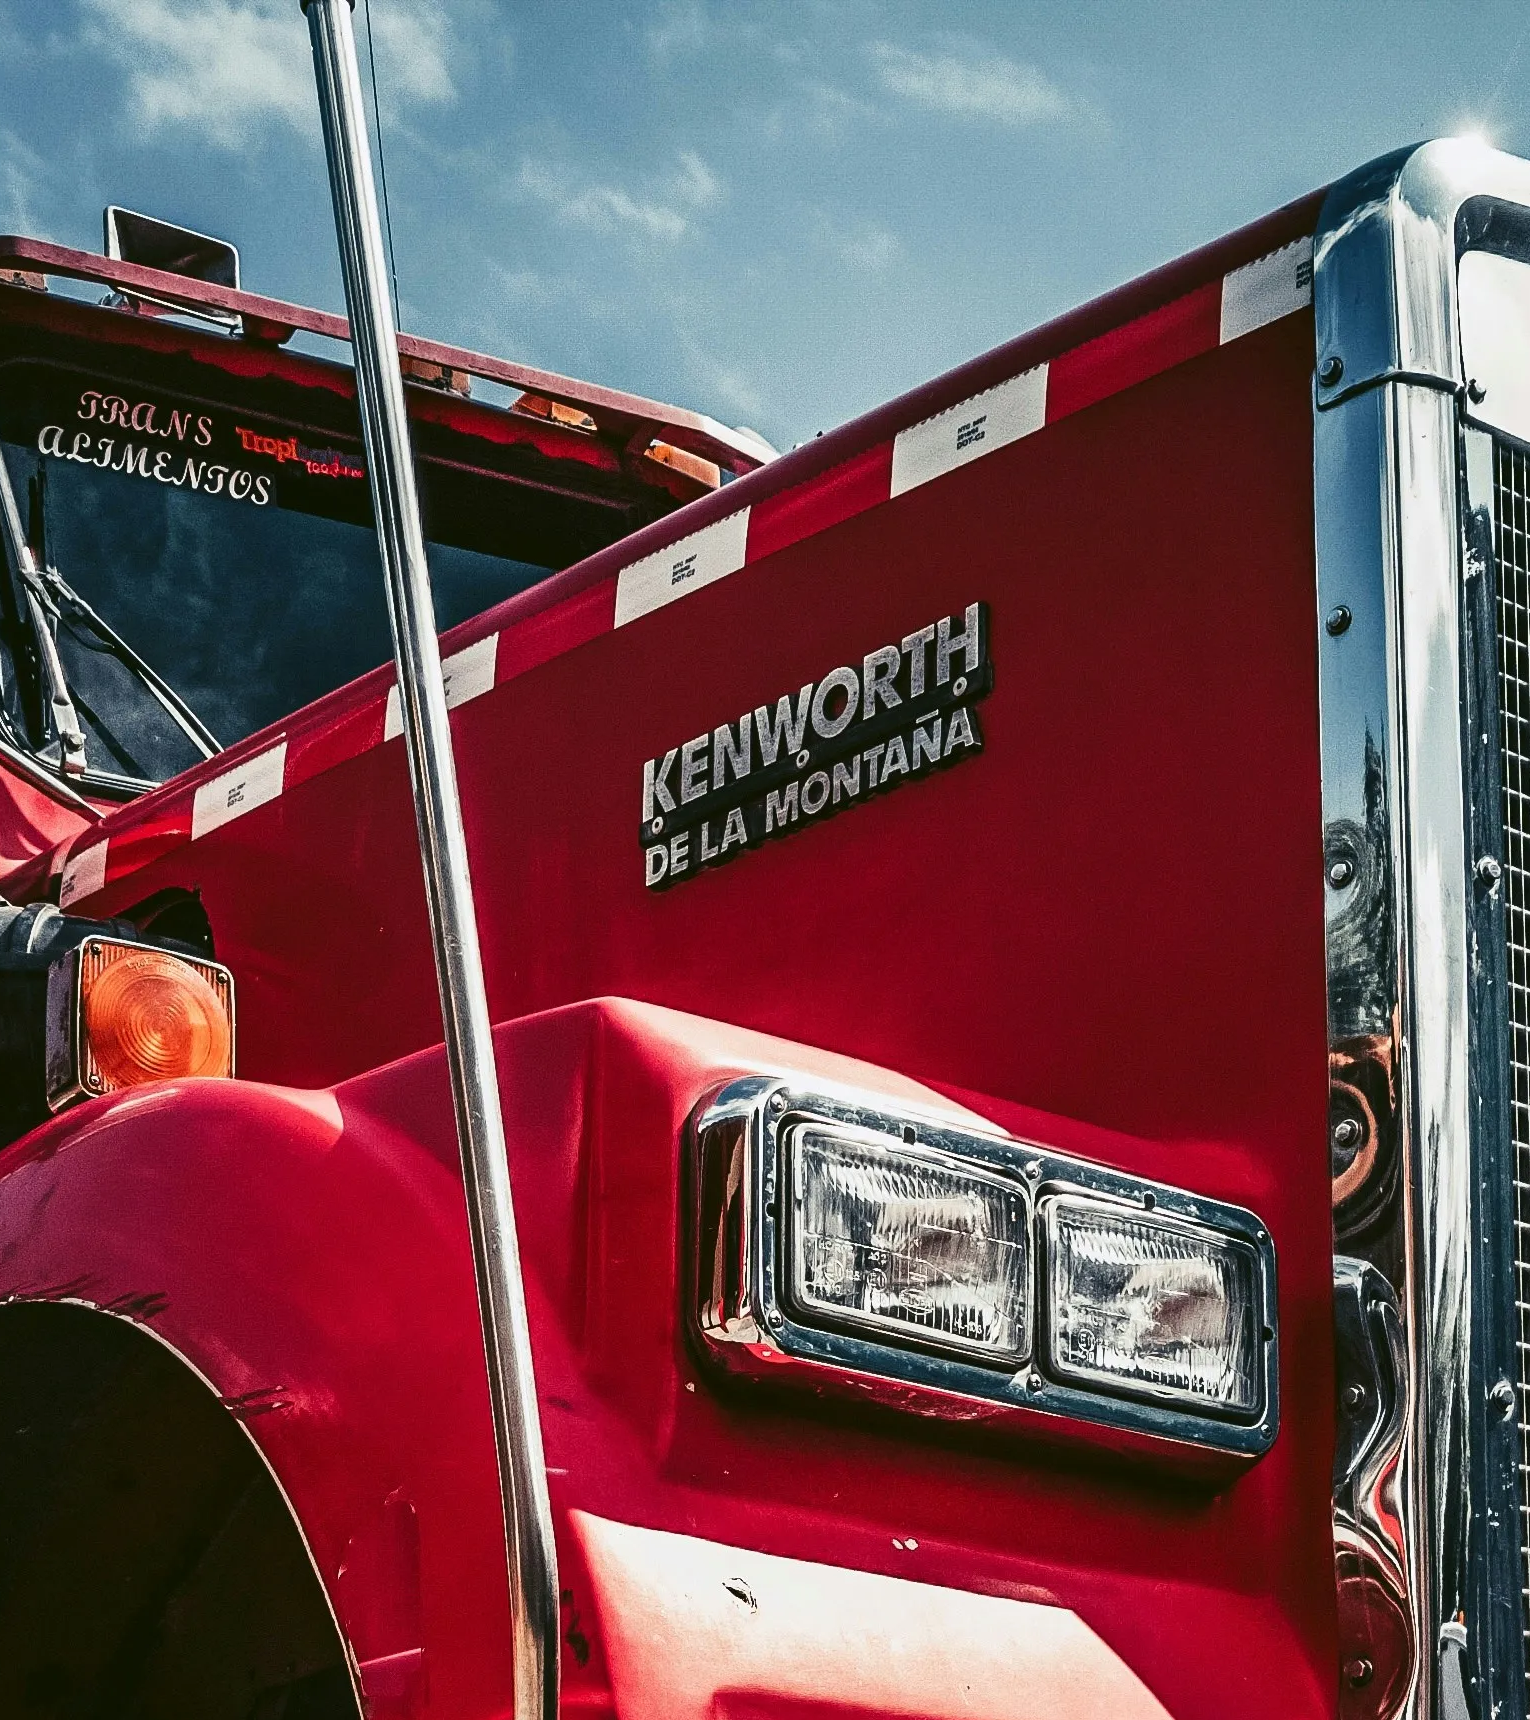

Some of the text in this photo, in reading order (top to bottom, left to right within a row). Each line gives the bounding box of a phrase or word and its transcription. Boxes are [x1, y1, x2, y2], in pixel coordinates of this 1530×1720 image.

[38, 425, 271, 505] ALIMENTOS
[77, 391, 213, 446] TRANS
[643, 602, 979, 823] KENWORTH
[645, 708, 981, 887] DE LA MONTAÑA
